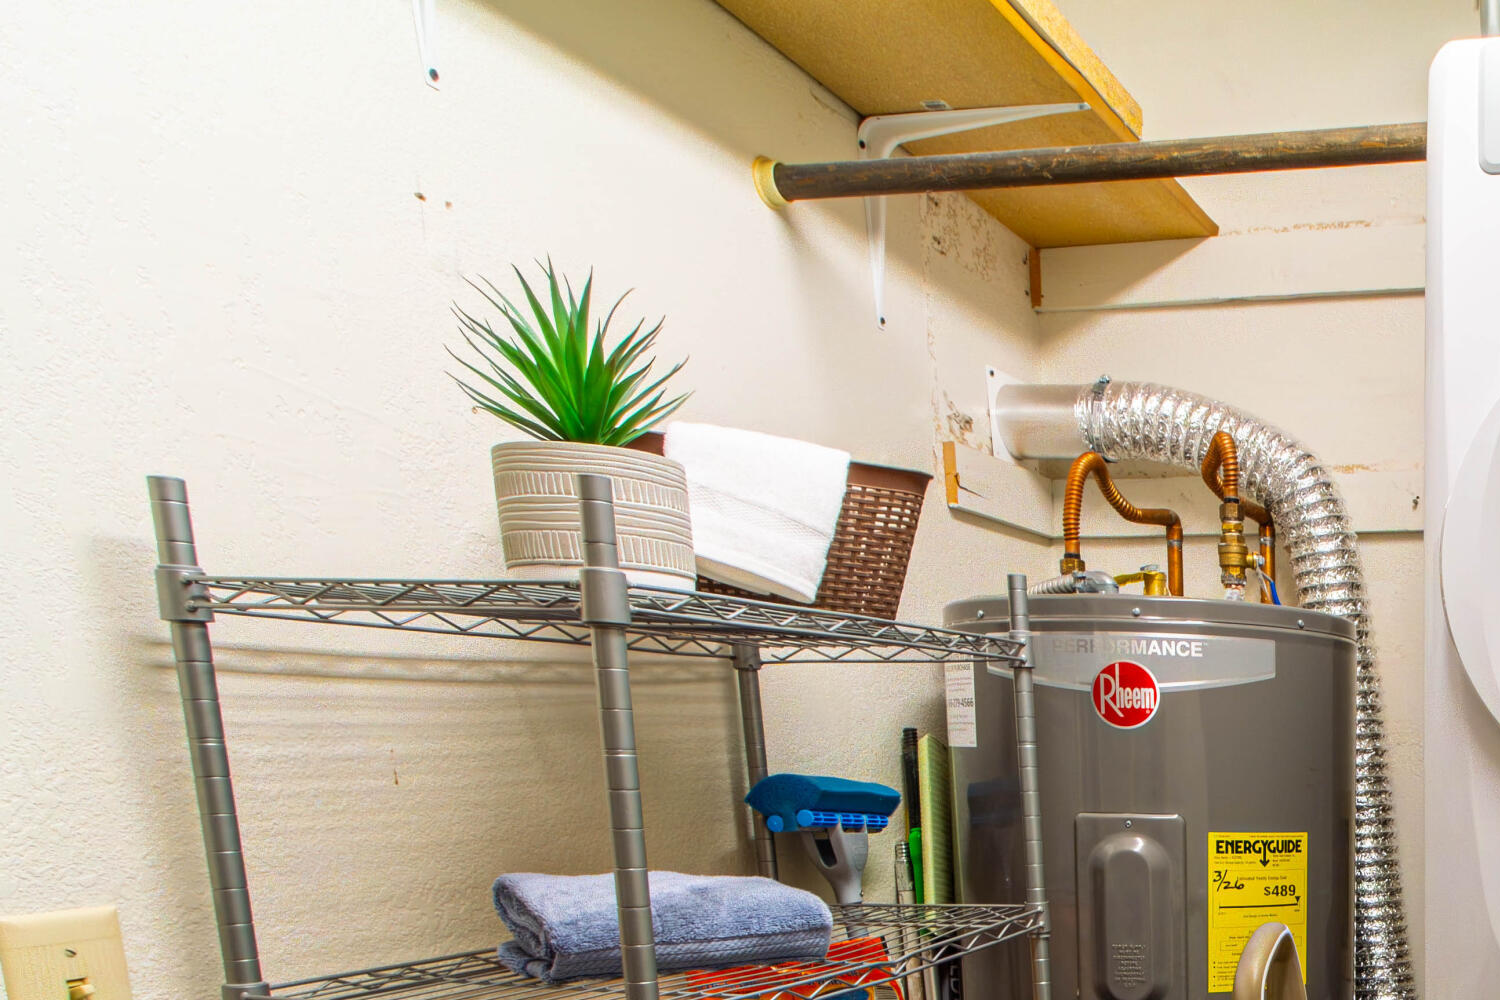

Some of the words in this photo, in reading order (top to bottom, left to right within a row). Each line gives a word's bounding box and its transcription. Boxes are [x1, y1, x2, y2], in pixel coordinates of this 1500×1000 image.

[1099, 663, 1155, 718] Rheem
[1216, 840, 1302, 854] ENERGYGUIDE
[1213, 869, 1245, 892] 3/26
[1263, 884, 1296, 897] $489
